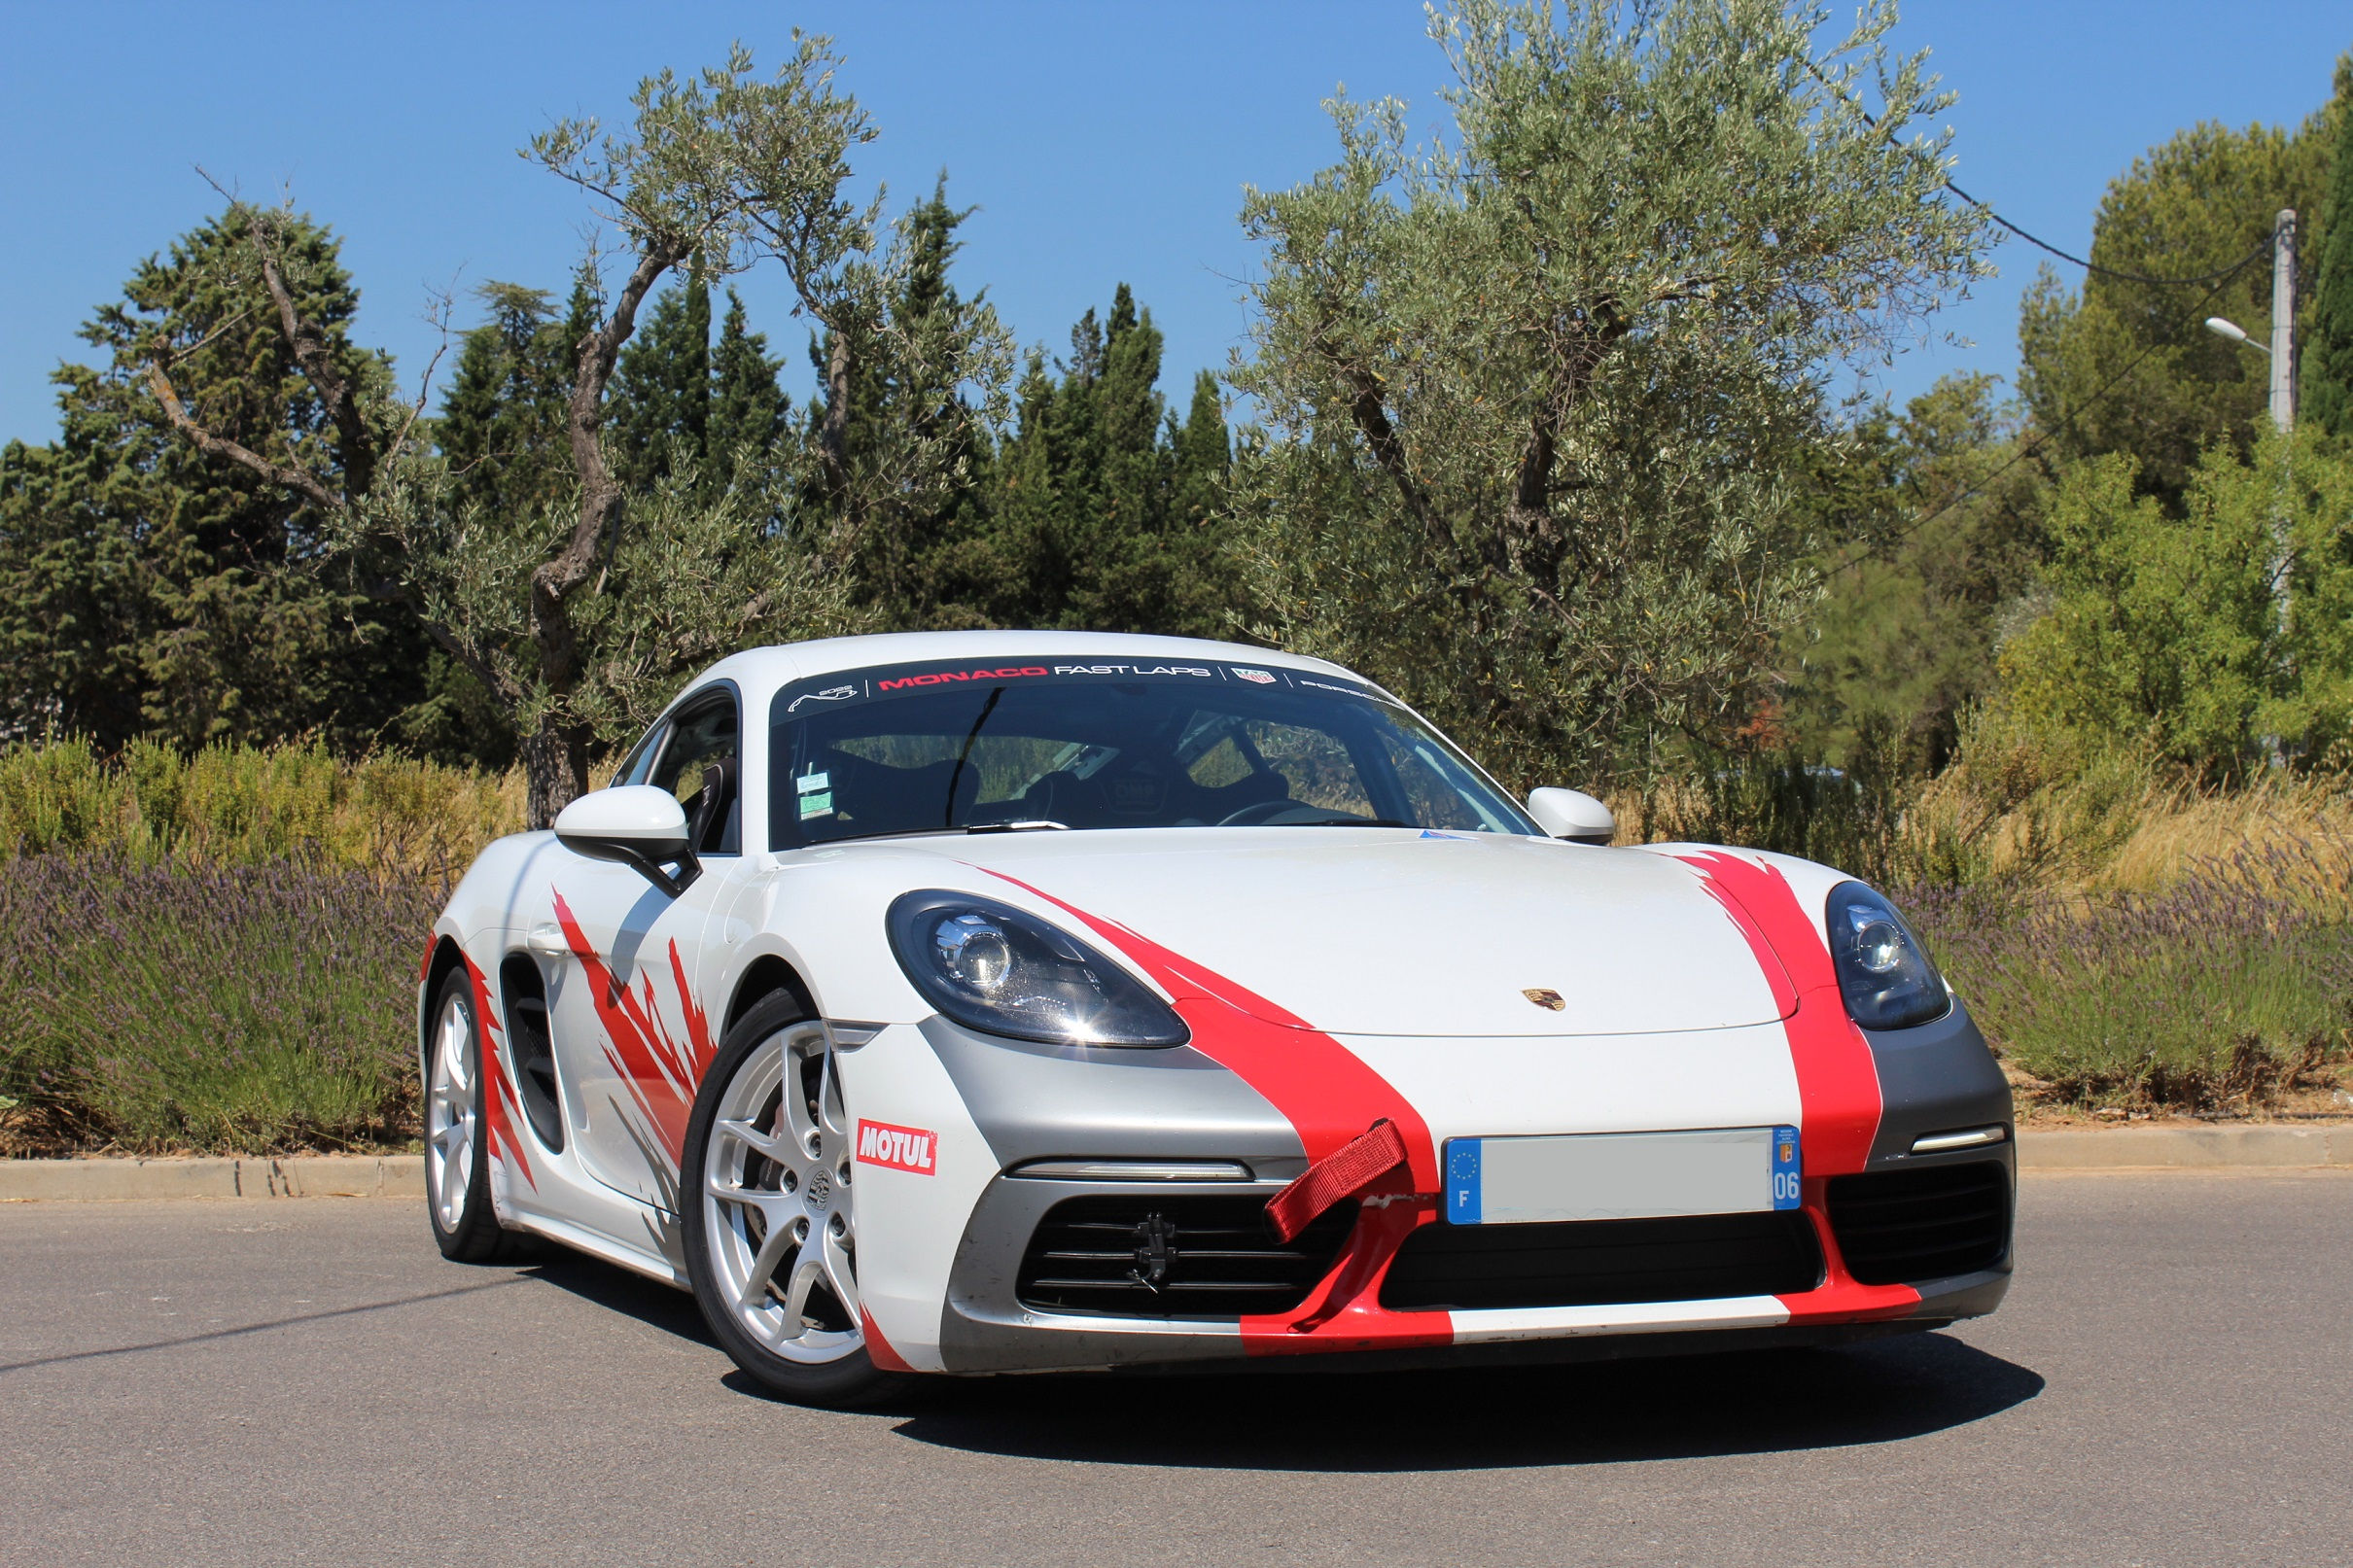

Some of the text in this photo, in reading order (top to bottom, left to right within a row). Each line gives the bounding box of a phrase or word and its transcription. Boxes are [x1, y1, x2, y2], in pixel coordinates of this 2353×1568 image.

[819, 684, 853, 695] 2022
[878, 665, 1212, 691] MONACO FAST LAPS
[860, 1126, 932, 1168] MOTUL
[1458, 1190, 1469, 1207] F
[1774, 1171, 1799, 1200] 06
